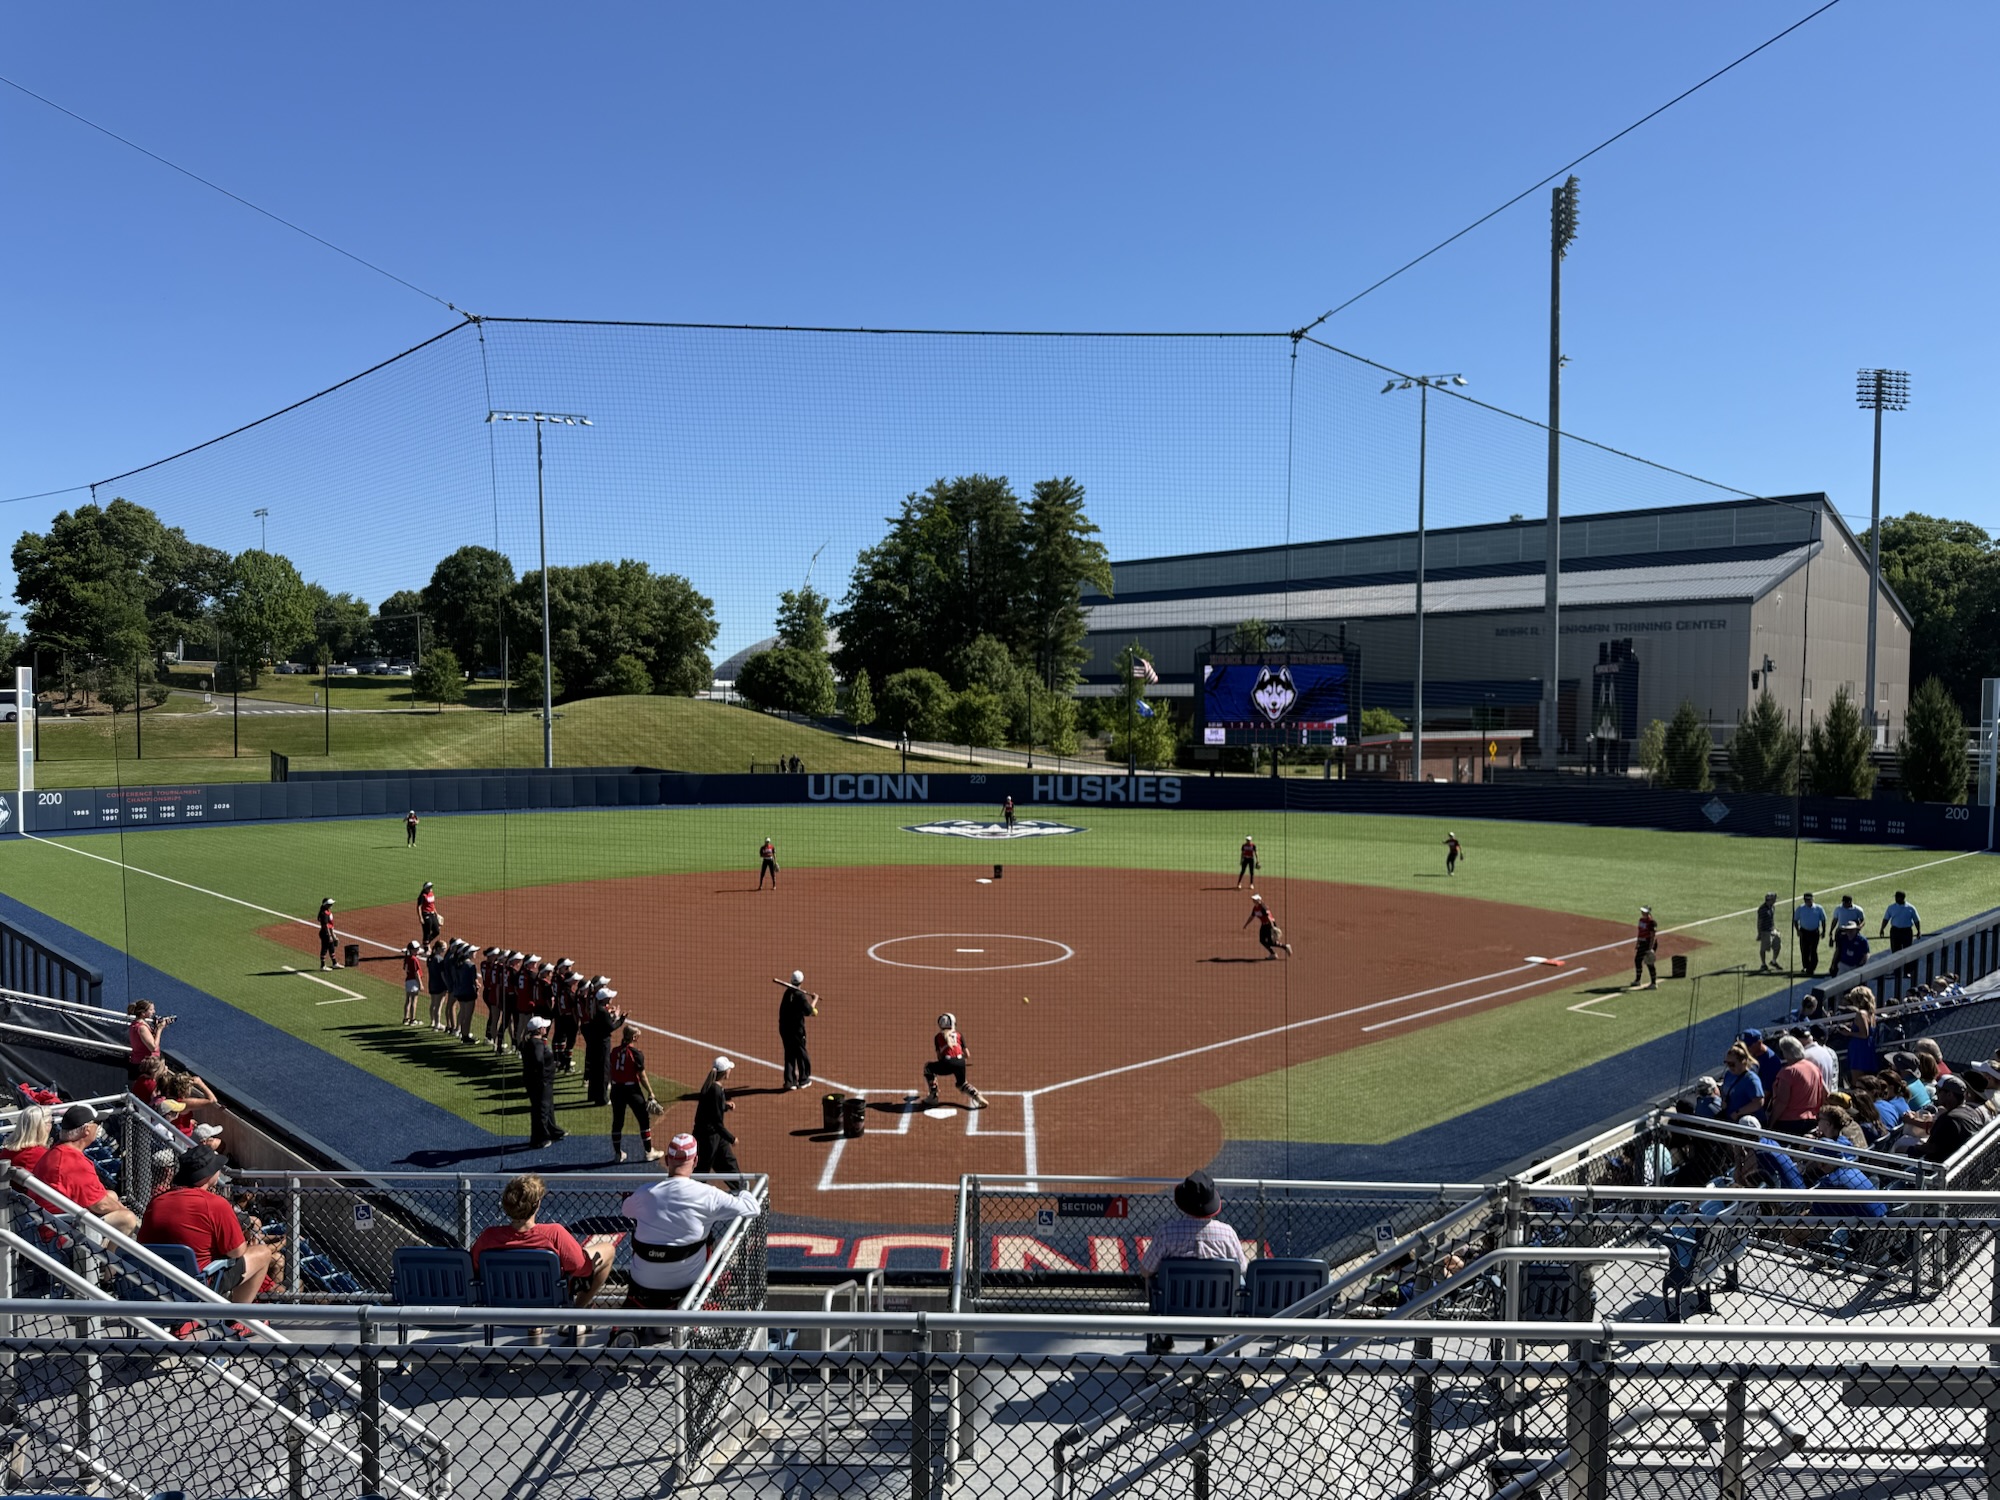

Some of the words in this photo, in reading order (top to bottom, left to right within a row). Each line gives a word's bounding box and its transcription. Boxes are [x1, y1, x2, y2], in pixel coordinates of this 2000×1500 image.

[1613, 621, 1672, 633] TRAINING
[1676, 619, 1727, 632] CENTER
[970, 775, 987, 784] 220
[807, 774, 928, 801] UCONN
[1033, 775, 1182, 804] HUSKIES
[38, 792, 63, 805] 200
[106, 790, 153, 799] CONFERENCE
[126, 795, 182, 803] CHAMPIONSHIPS
[1945, 807, 1969, 820] 200
[1061, 1202, 1104, 1212] SECTION
[1116, 1200, 1123, 1215] 1
